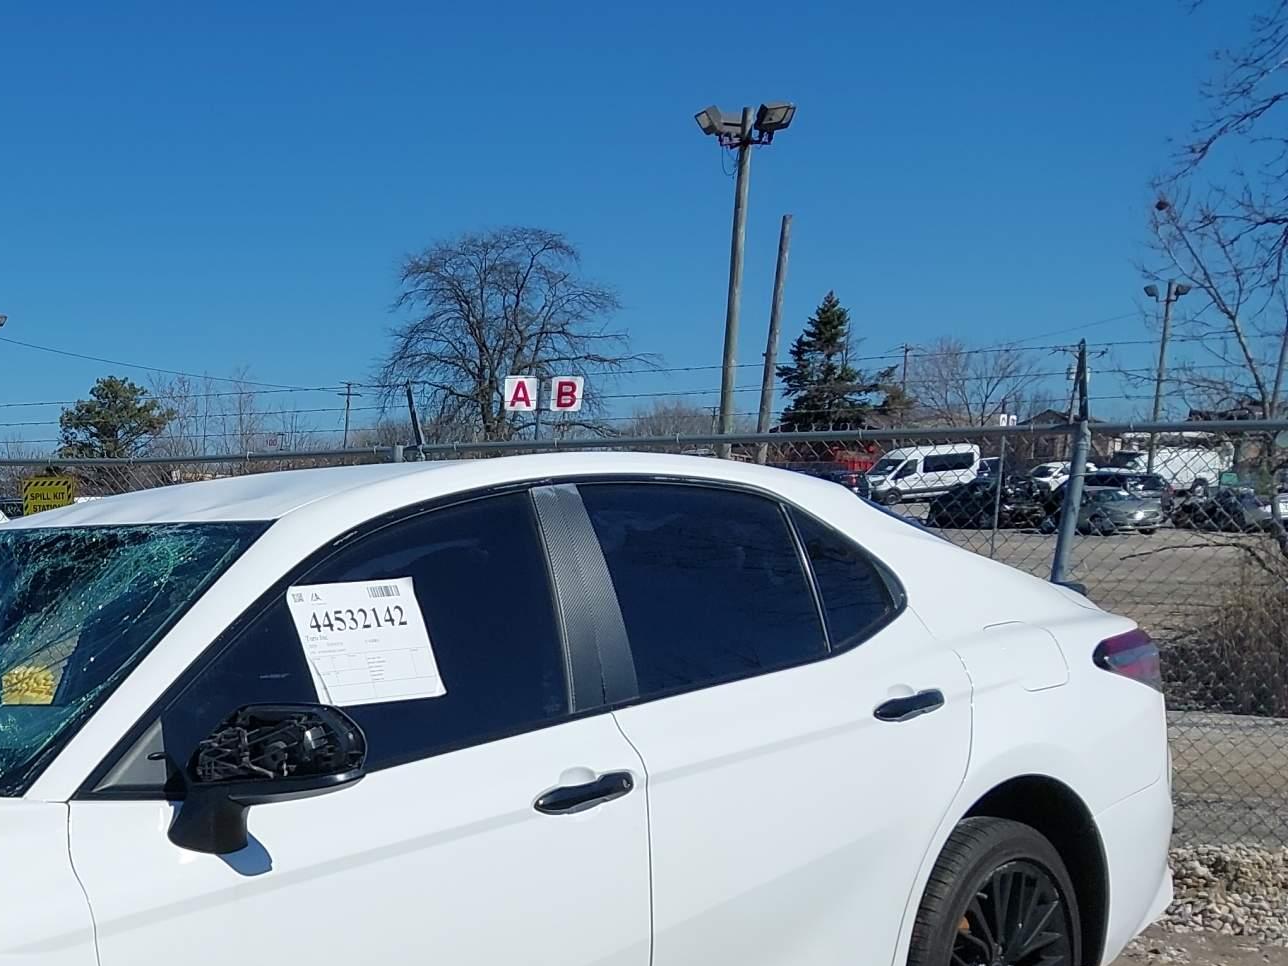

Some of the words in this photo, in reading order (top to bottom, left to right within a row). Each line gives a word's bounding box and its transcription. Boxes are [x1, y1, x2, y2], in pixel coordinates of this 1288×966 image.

[510, 381, 531, 407] A
[556, 381, 577, 407] B
[30, 492, 51, 500] SPILL
[53, 492, 65, 500] KIT
[309, 605, 408, 633] 44532142
